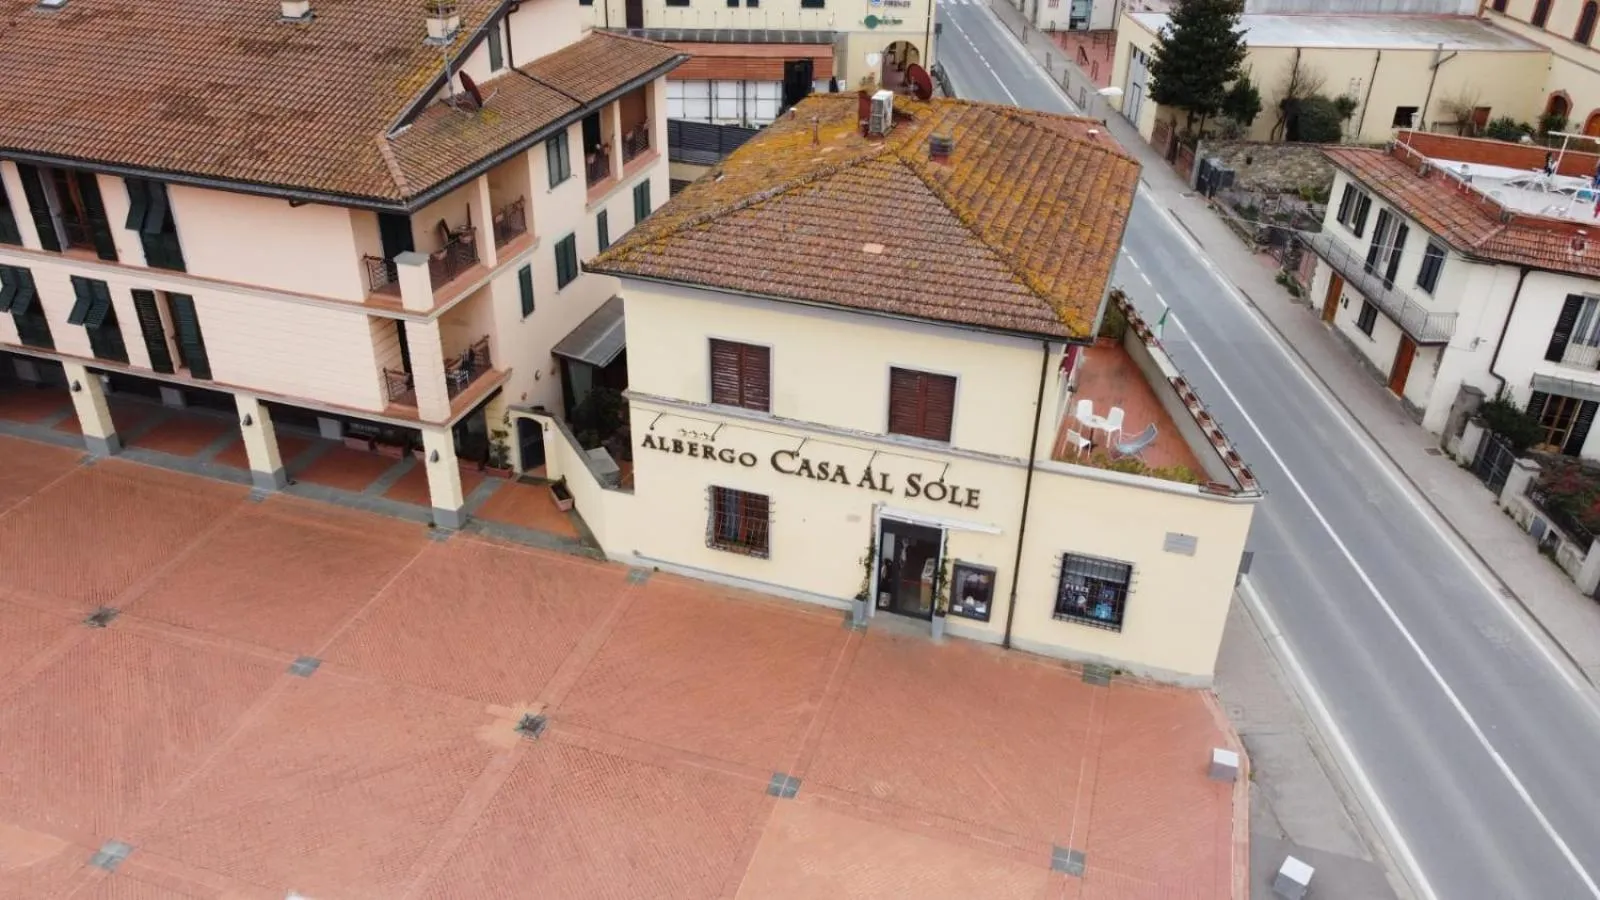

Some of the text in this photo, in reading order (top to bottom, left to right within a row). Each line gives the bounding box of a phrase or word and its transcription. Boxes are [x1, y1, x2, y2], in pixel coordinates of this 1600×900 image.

[641, 433, 981, 510] ALBERGO CASA AL SOLE
